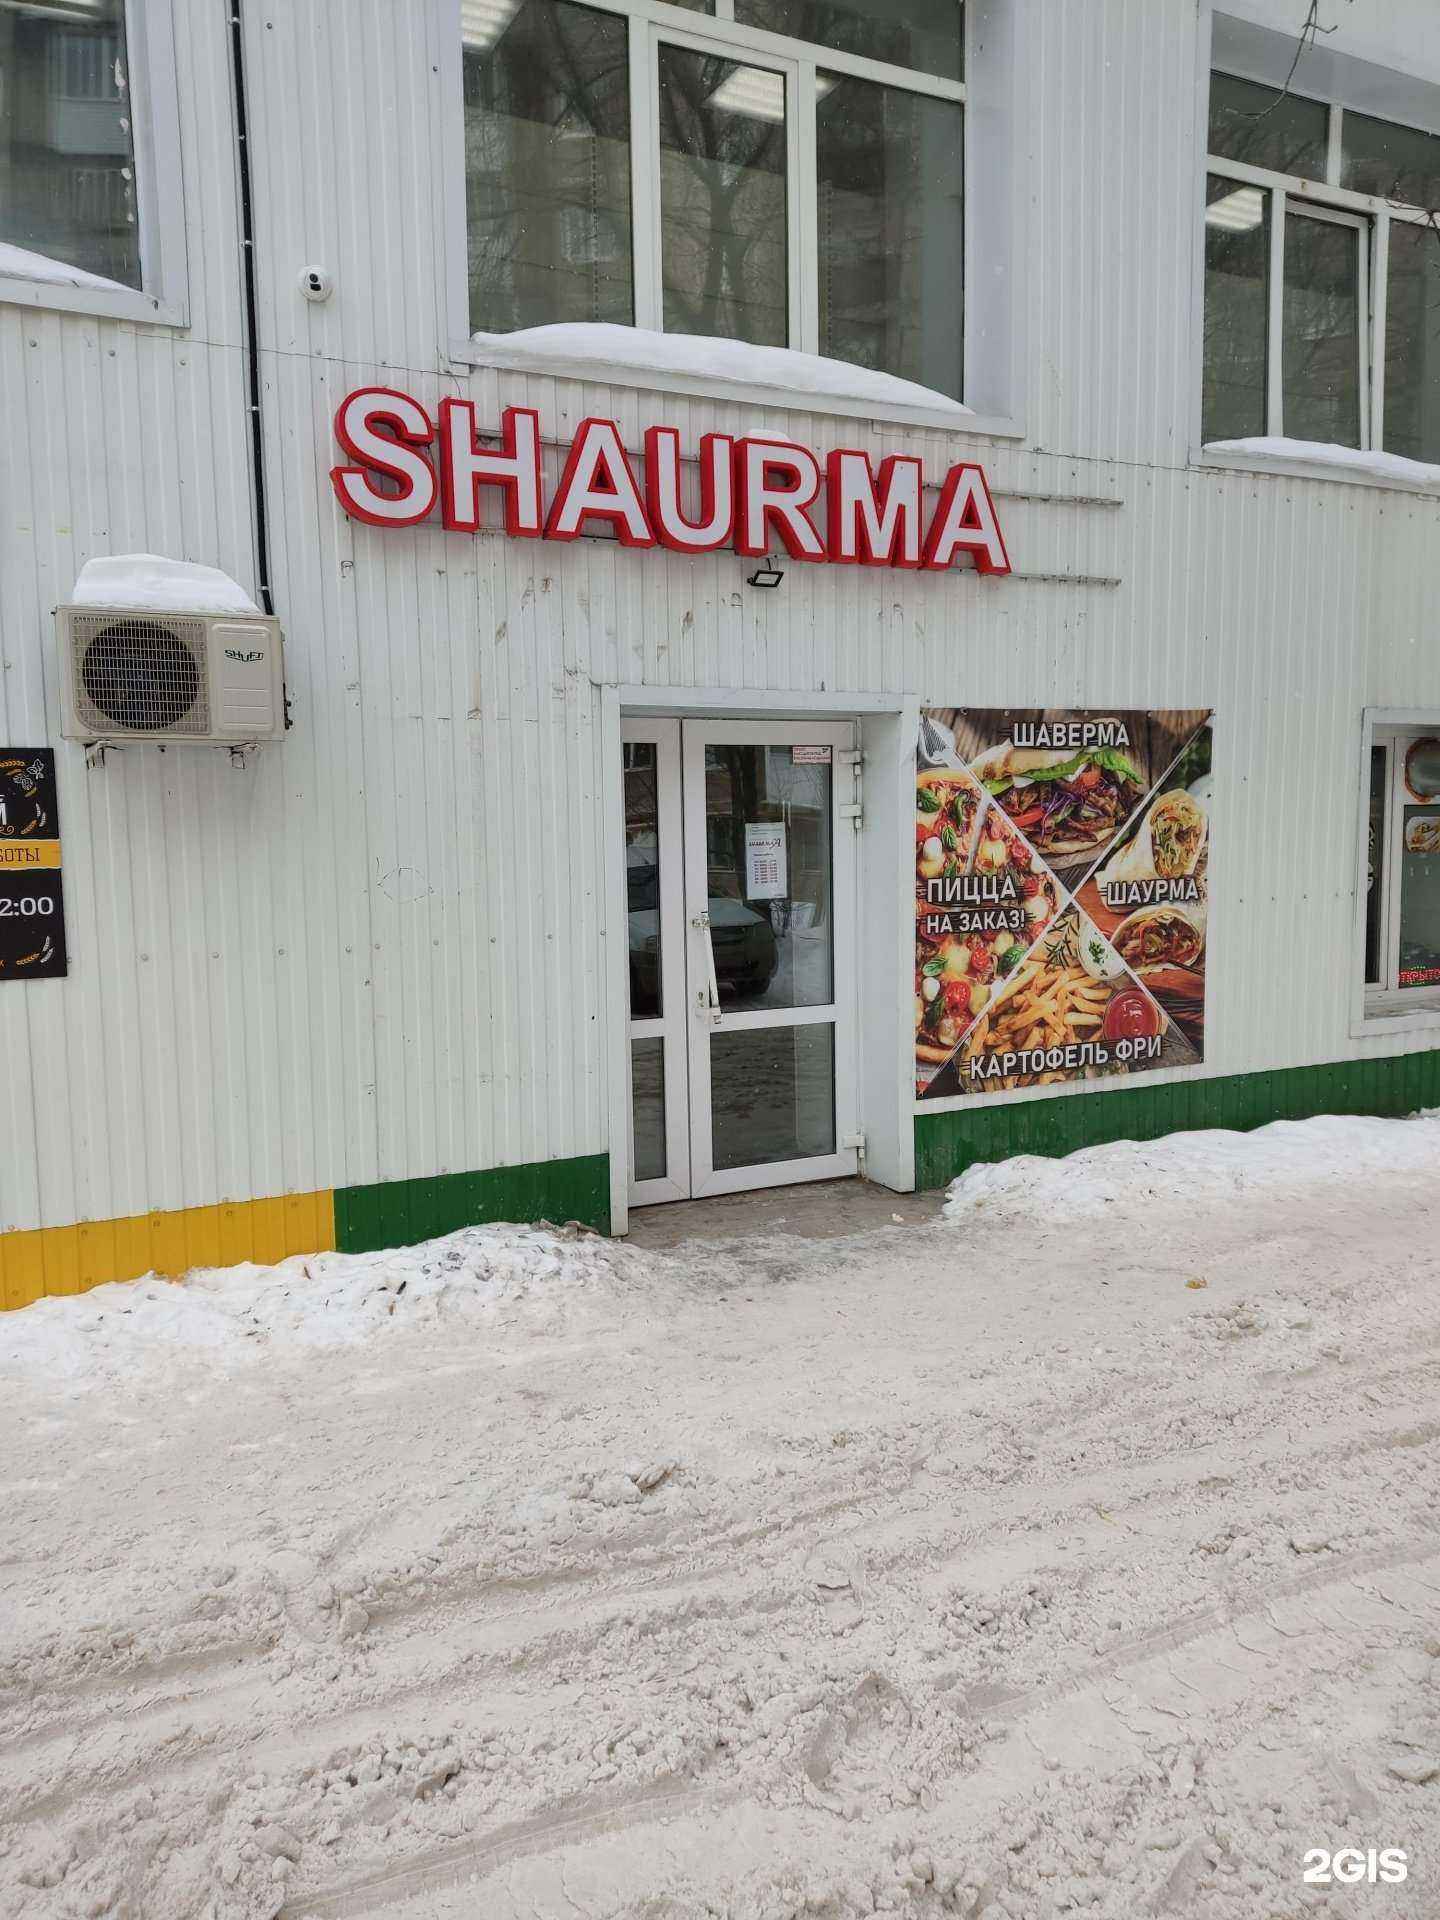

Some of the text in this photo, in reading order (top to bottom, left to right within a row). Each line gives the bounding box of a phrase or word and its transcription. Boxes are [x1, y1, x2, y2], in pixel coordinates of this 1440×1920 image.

[330, 387, 1012, 575] SHAURMA
[1013, 721, 1130, 747] ШАВЕРМА
[926, 875, 1017, 905] ПИЦЦА
[1107, 878, 1199, 905] ШАУРМА
[926, 909, 1025, 934] НА ЗАКАЗ!
[970, 1034, 1162, 1080] КАРТОФЕЛЬ ФРИ
